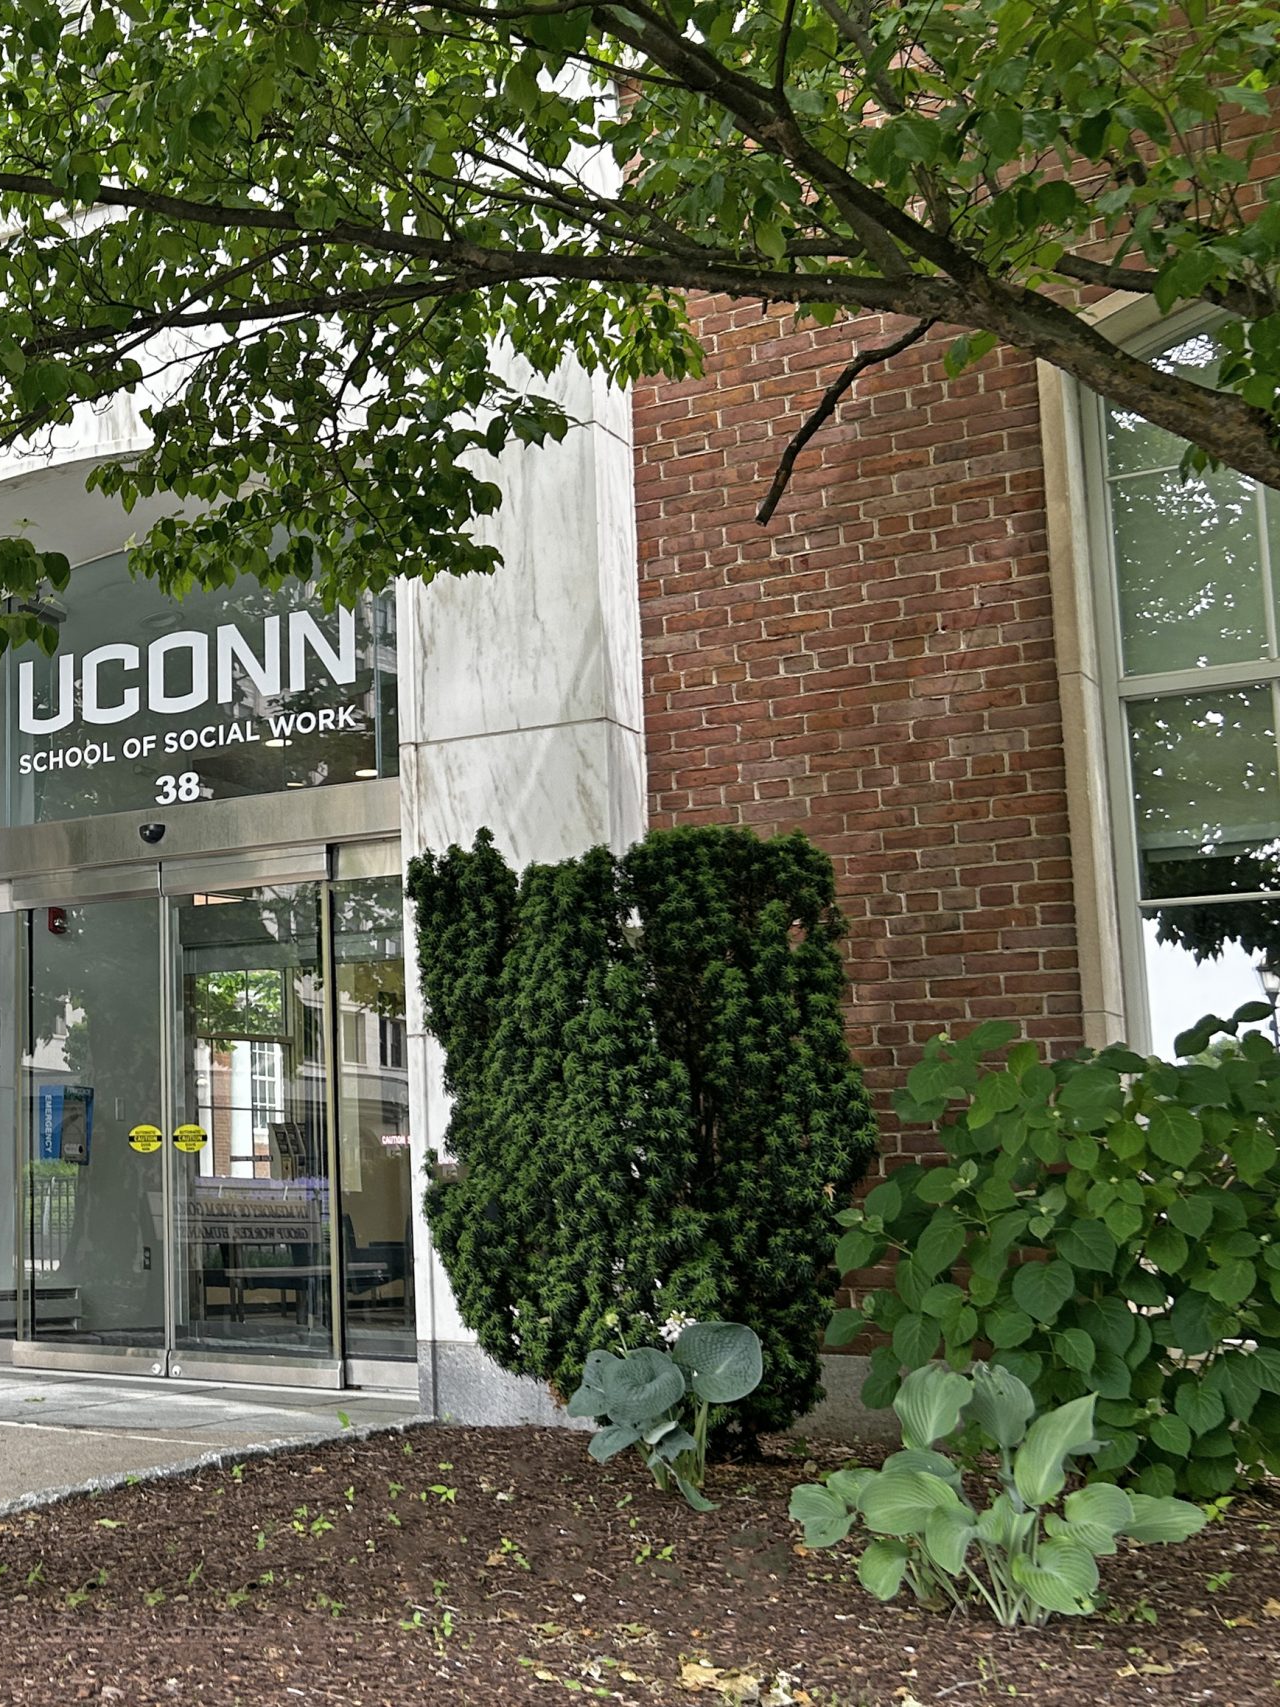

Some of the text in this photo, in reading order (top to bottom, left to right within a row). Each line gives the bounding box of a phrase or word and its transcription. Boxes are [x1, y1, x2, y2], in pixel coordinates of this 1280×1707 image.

[19, 604, 356, 735] UCONN
[19, 704, 357, 775] SCHOOL OF SOCIAL WORK
[154, 771, 200, 805] 38
[45, 1094, 53, 1153] EMERGENCY
[134, 1134, 158, 1142] CAUTION
[178, 1134, 203, 1142] CAUTION
[382, 1136, 406, 1144] CAUTION
